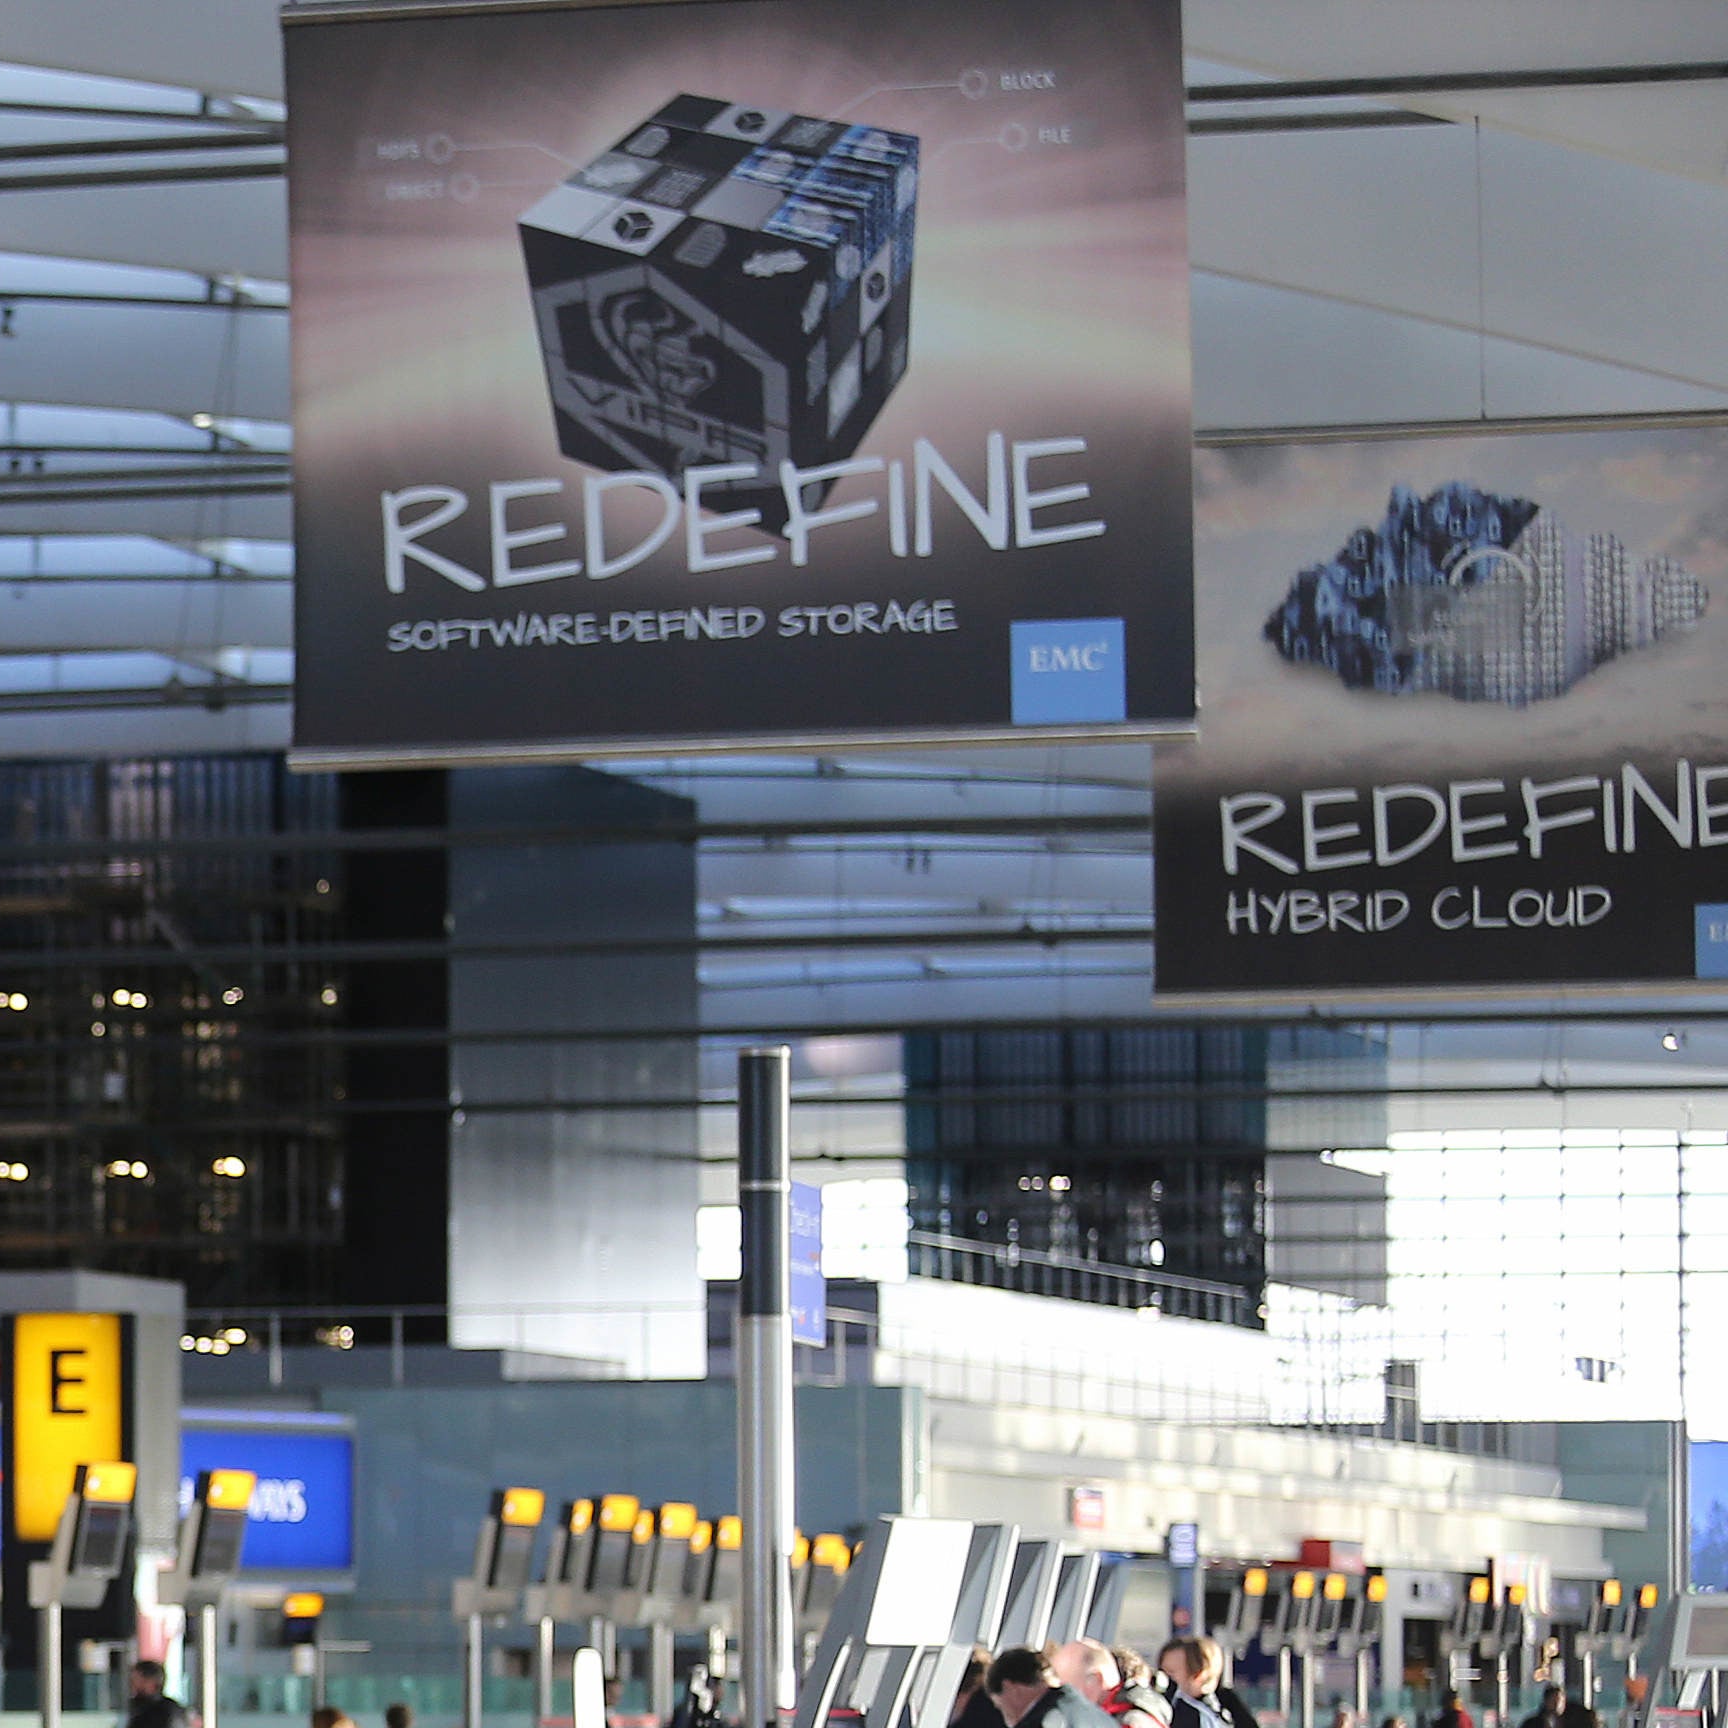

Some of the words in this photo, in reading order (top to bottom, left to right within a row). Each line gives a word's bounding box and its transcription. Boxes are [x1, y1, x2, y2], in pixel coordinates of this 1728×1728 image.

[381, 431, 1106, 595] REDEFINE
[387, 605, 765, 653] SOFTWARE-DEFINED
[778, 598, 959, 636] STORAGE
[1226, 888, 1411, 936] HYBRID
[1431, 885, 1612, 930] CLOUD
[50, 1349, 88, 1415] E
